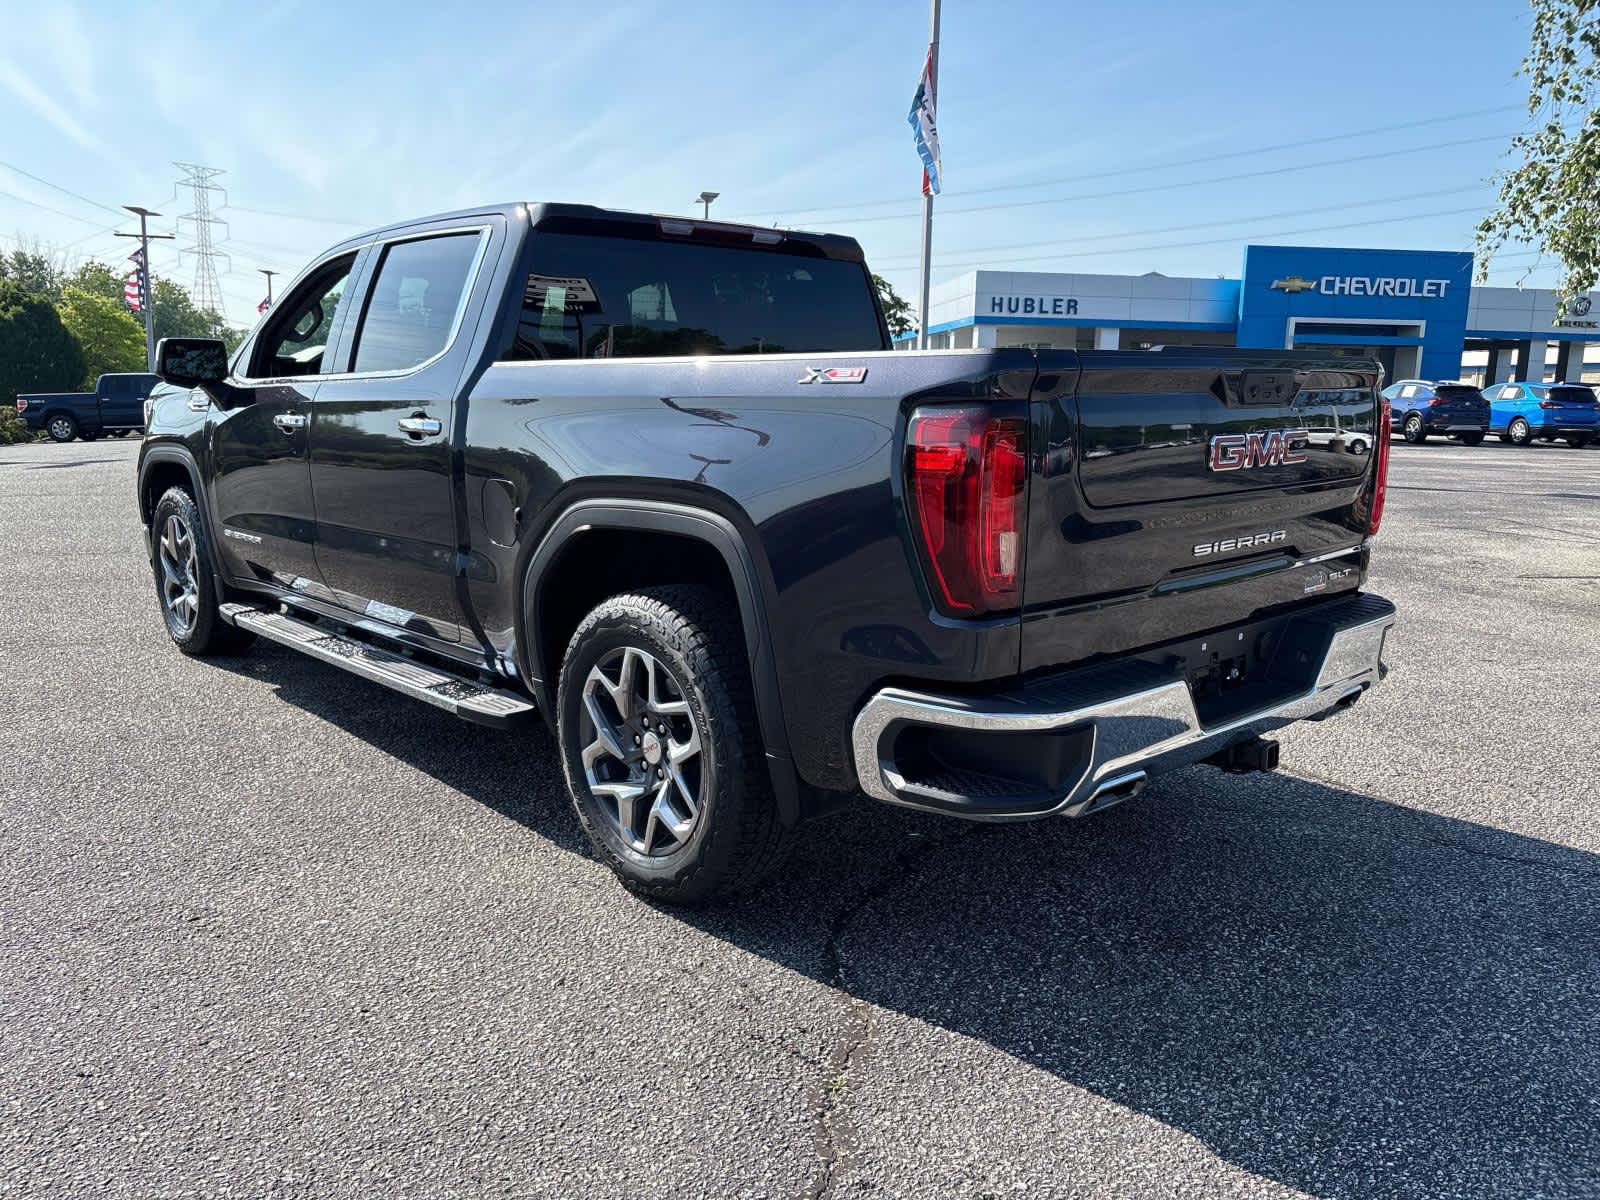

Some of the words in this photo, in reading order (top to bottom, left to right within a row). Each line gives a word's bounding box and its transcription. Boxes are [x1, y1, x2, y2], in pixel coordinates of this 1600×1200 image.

[1320, 276, 1451, 298] CHEVROLET
[991, 296, 1079, 315] HUBLER
[1209, 430, 1309, 472] GMC
[1192, 529, 1287, 557] SIERRA
[1328, 569, 1352, 581] SLT
